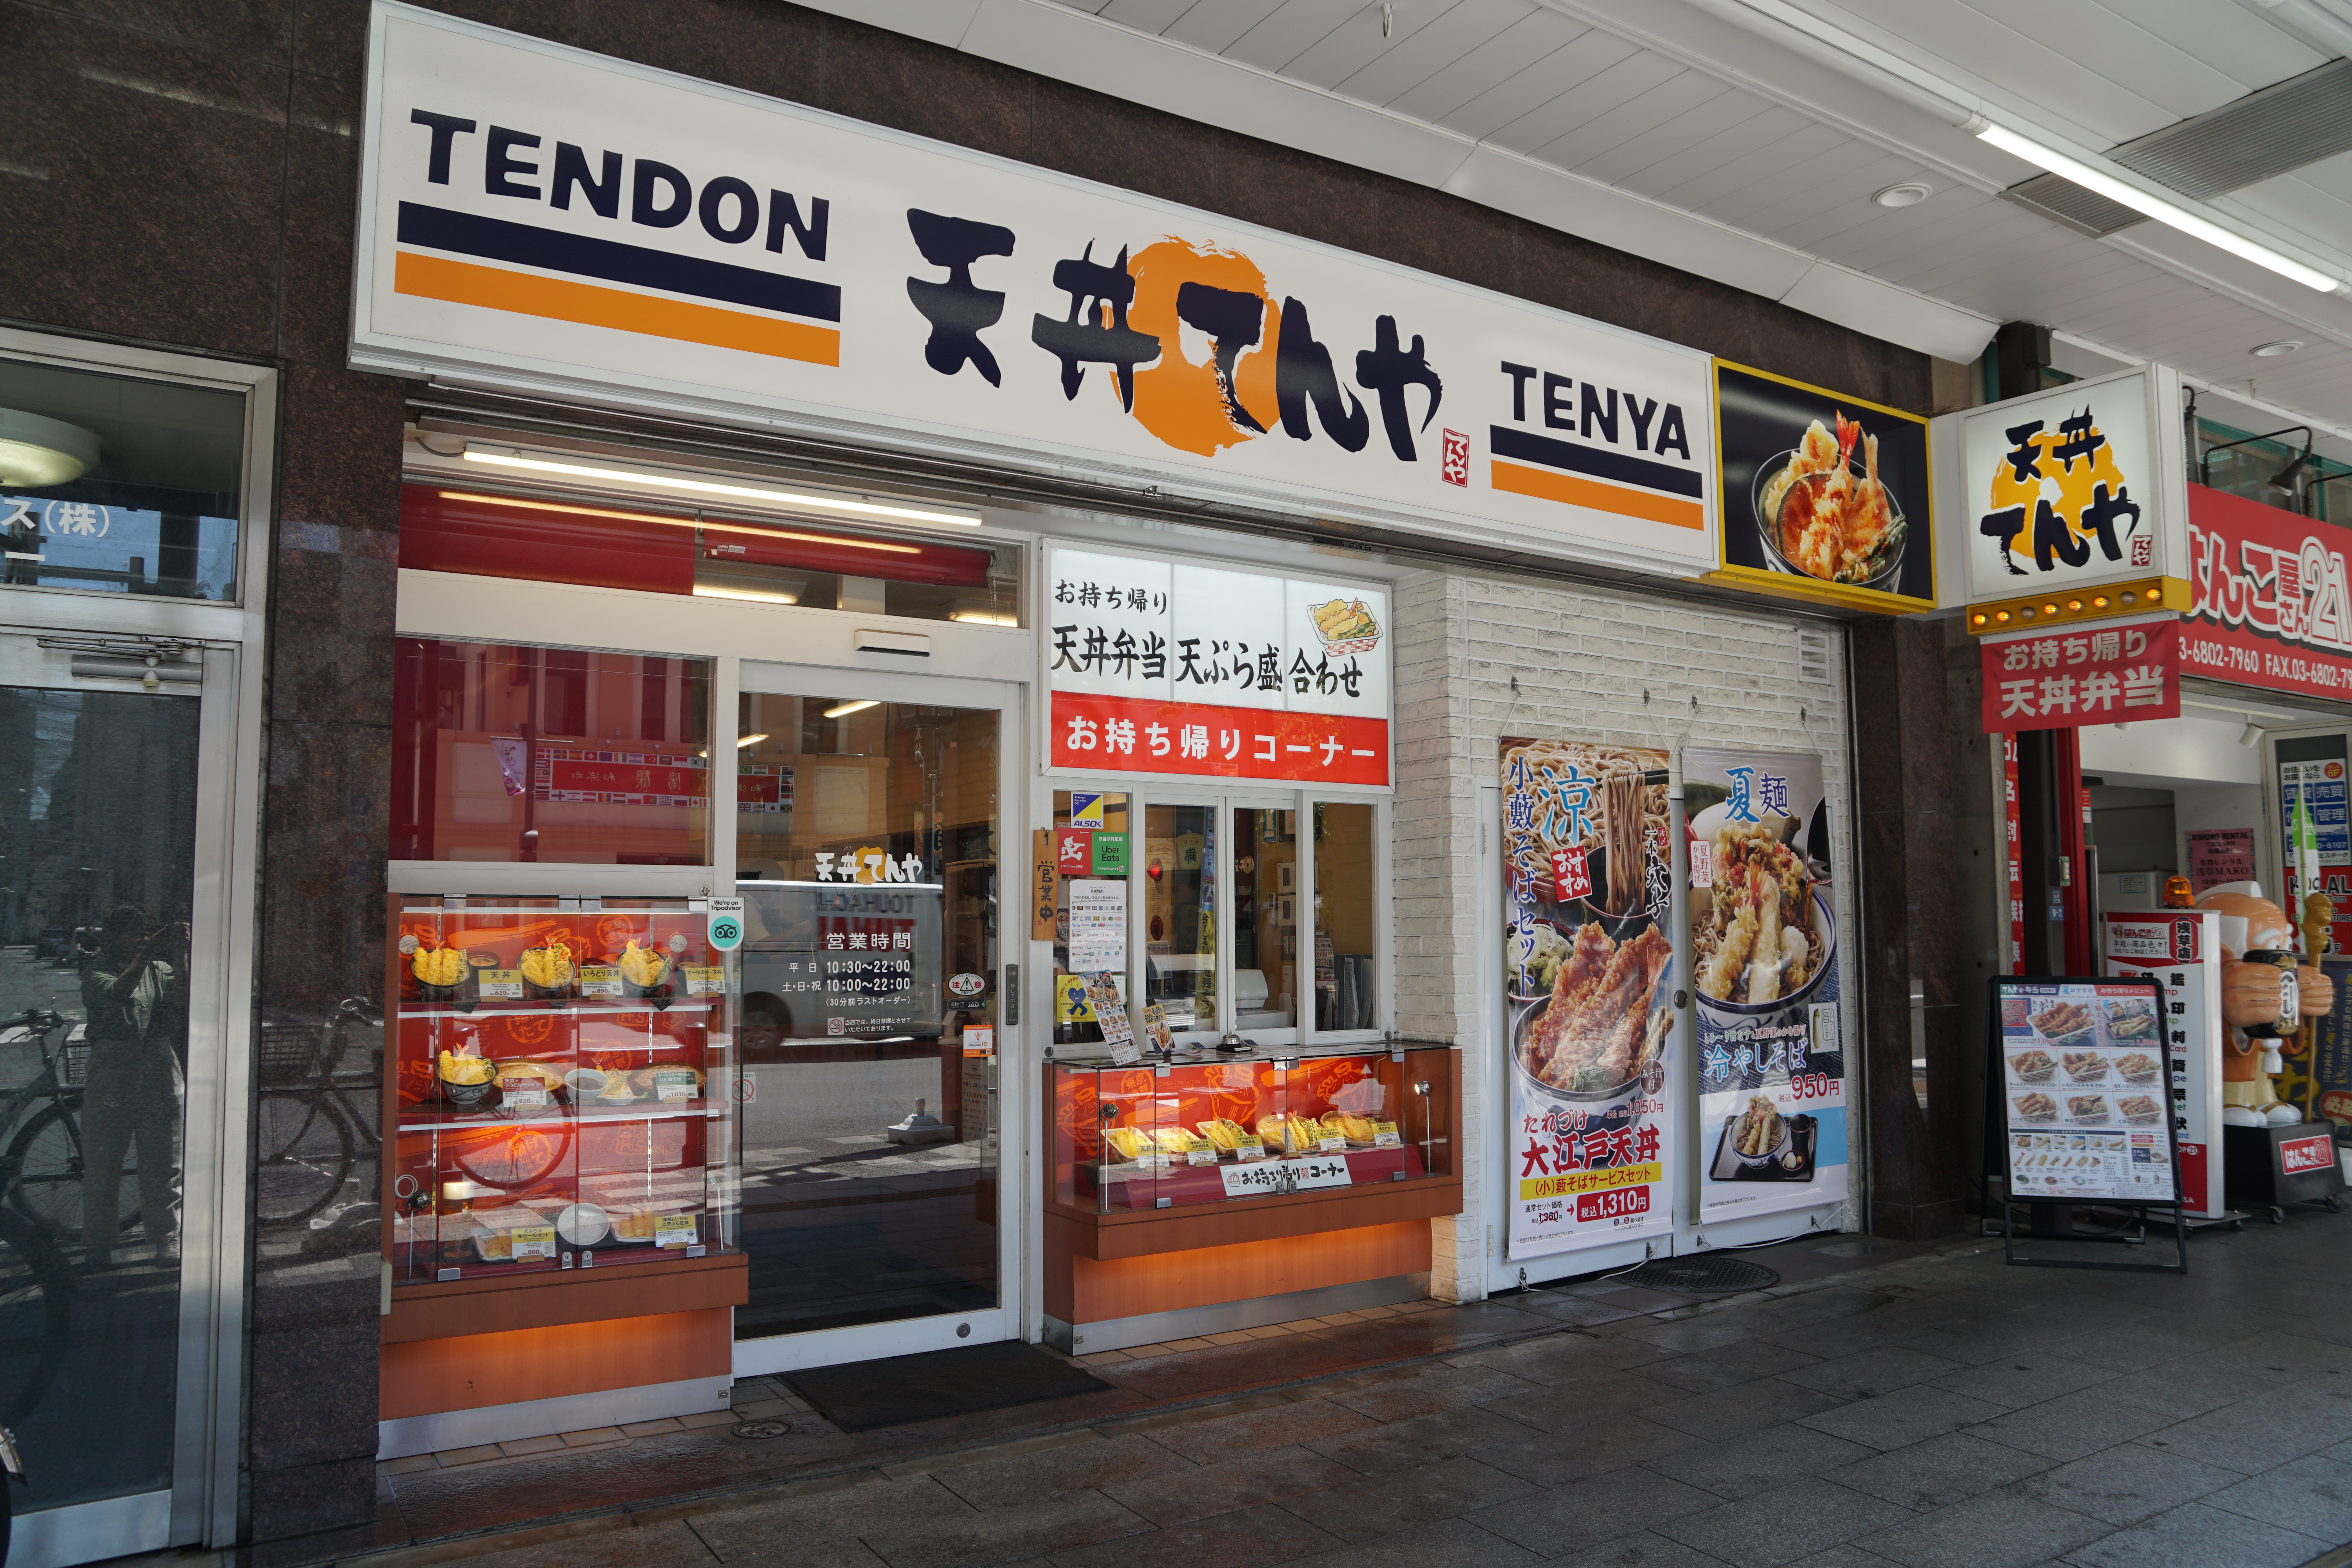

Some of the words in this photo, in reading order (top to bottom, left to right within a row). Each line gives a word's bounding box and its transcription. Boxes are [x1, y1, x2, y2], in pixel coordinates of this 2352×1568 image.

[410, 108, 829, 262] TENDON
[907, 208, 1443, 462] 天丼てんや
[1501, 360, 1691, 460] TENYA
[2005, 403, 2105, 483] 天丼
[0, 498, 109, 537] ス(株)
[1980, 483, 2141, 576] てんや
[1055, 579, 1167, 615] お持ち帰り
[1051, 624, 1166, 681] 天丼弁当
[1175, 637, 1283, 691] 天ぷら盛
[1288, 647, 1363, 698] 合わせ
[2004, 630, 2147, 671] お持ち帰り
[2000, 665, 2164, 719] 天丼弁当
[1067, 715, 1376, 767] お持ち帰りコーナー
[2283, 765, 2320, 773] お住いを
[2283, 772, 2320, 781] お探なら
[2327, 769, 2341, 777] 6F
[1539, 765, 1595, 846] 涼
[2316, 785, 2344, 799] 売買
[2317, 808, 2346, 822] 管理
[815, 850, 922, 883] 天丼てんや
[1508, 756, 1538, 998] 小藪そばセット
[1645, 829, 1669, 918] 一本穴子
[1692, 844, 1700, 884] かき揚げ
[1699, 844, 1710, 884] 夏野菜
[2196, 866, 2249, 876] 浅草MAKO
[1037, 861, 1054, 922] 営業中
[2052, 909, 2062, 917] 9-2
[826, 932, 911, 950] 営業時間
[2176, 921, 2192, 959] 浅草店
[826, 960, 910, 974] 10:30～22:00
[782, 981, 821, 992] 土・日・祝
[826, 977, 910, 992] 10:00～22:00
[826, 996, 910, 1007] (30分前ラストオーダー)
[845, 1017, 911, 1025] 当店では、終日禁煙とさせて
[1641, 1067, 1663, 1079] みそ汁
[1705, 1037, 1808, 1082] 冷やしそば
[1648, 1079, 1656, 1090] 付
[1524, 1109, 1588, 1134] たれづけ
[1607, 1110, 1617, 1120] 単品
[1521, 1123, 1660, 1178] 大江戸天丼
[1310, 1162, 1345, 1178] コーナー
[1535, 1168, 1651, 1196] (小)藪そばサービスセット
[1525, 1200, 1562, 1213] 通常セット価格
[1516, 1230, 1575, 1244] ※食器は写真と異なる場合がございます。
